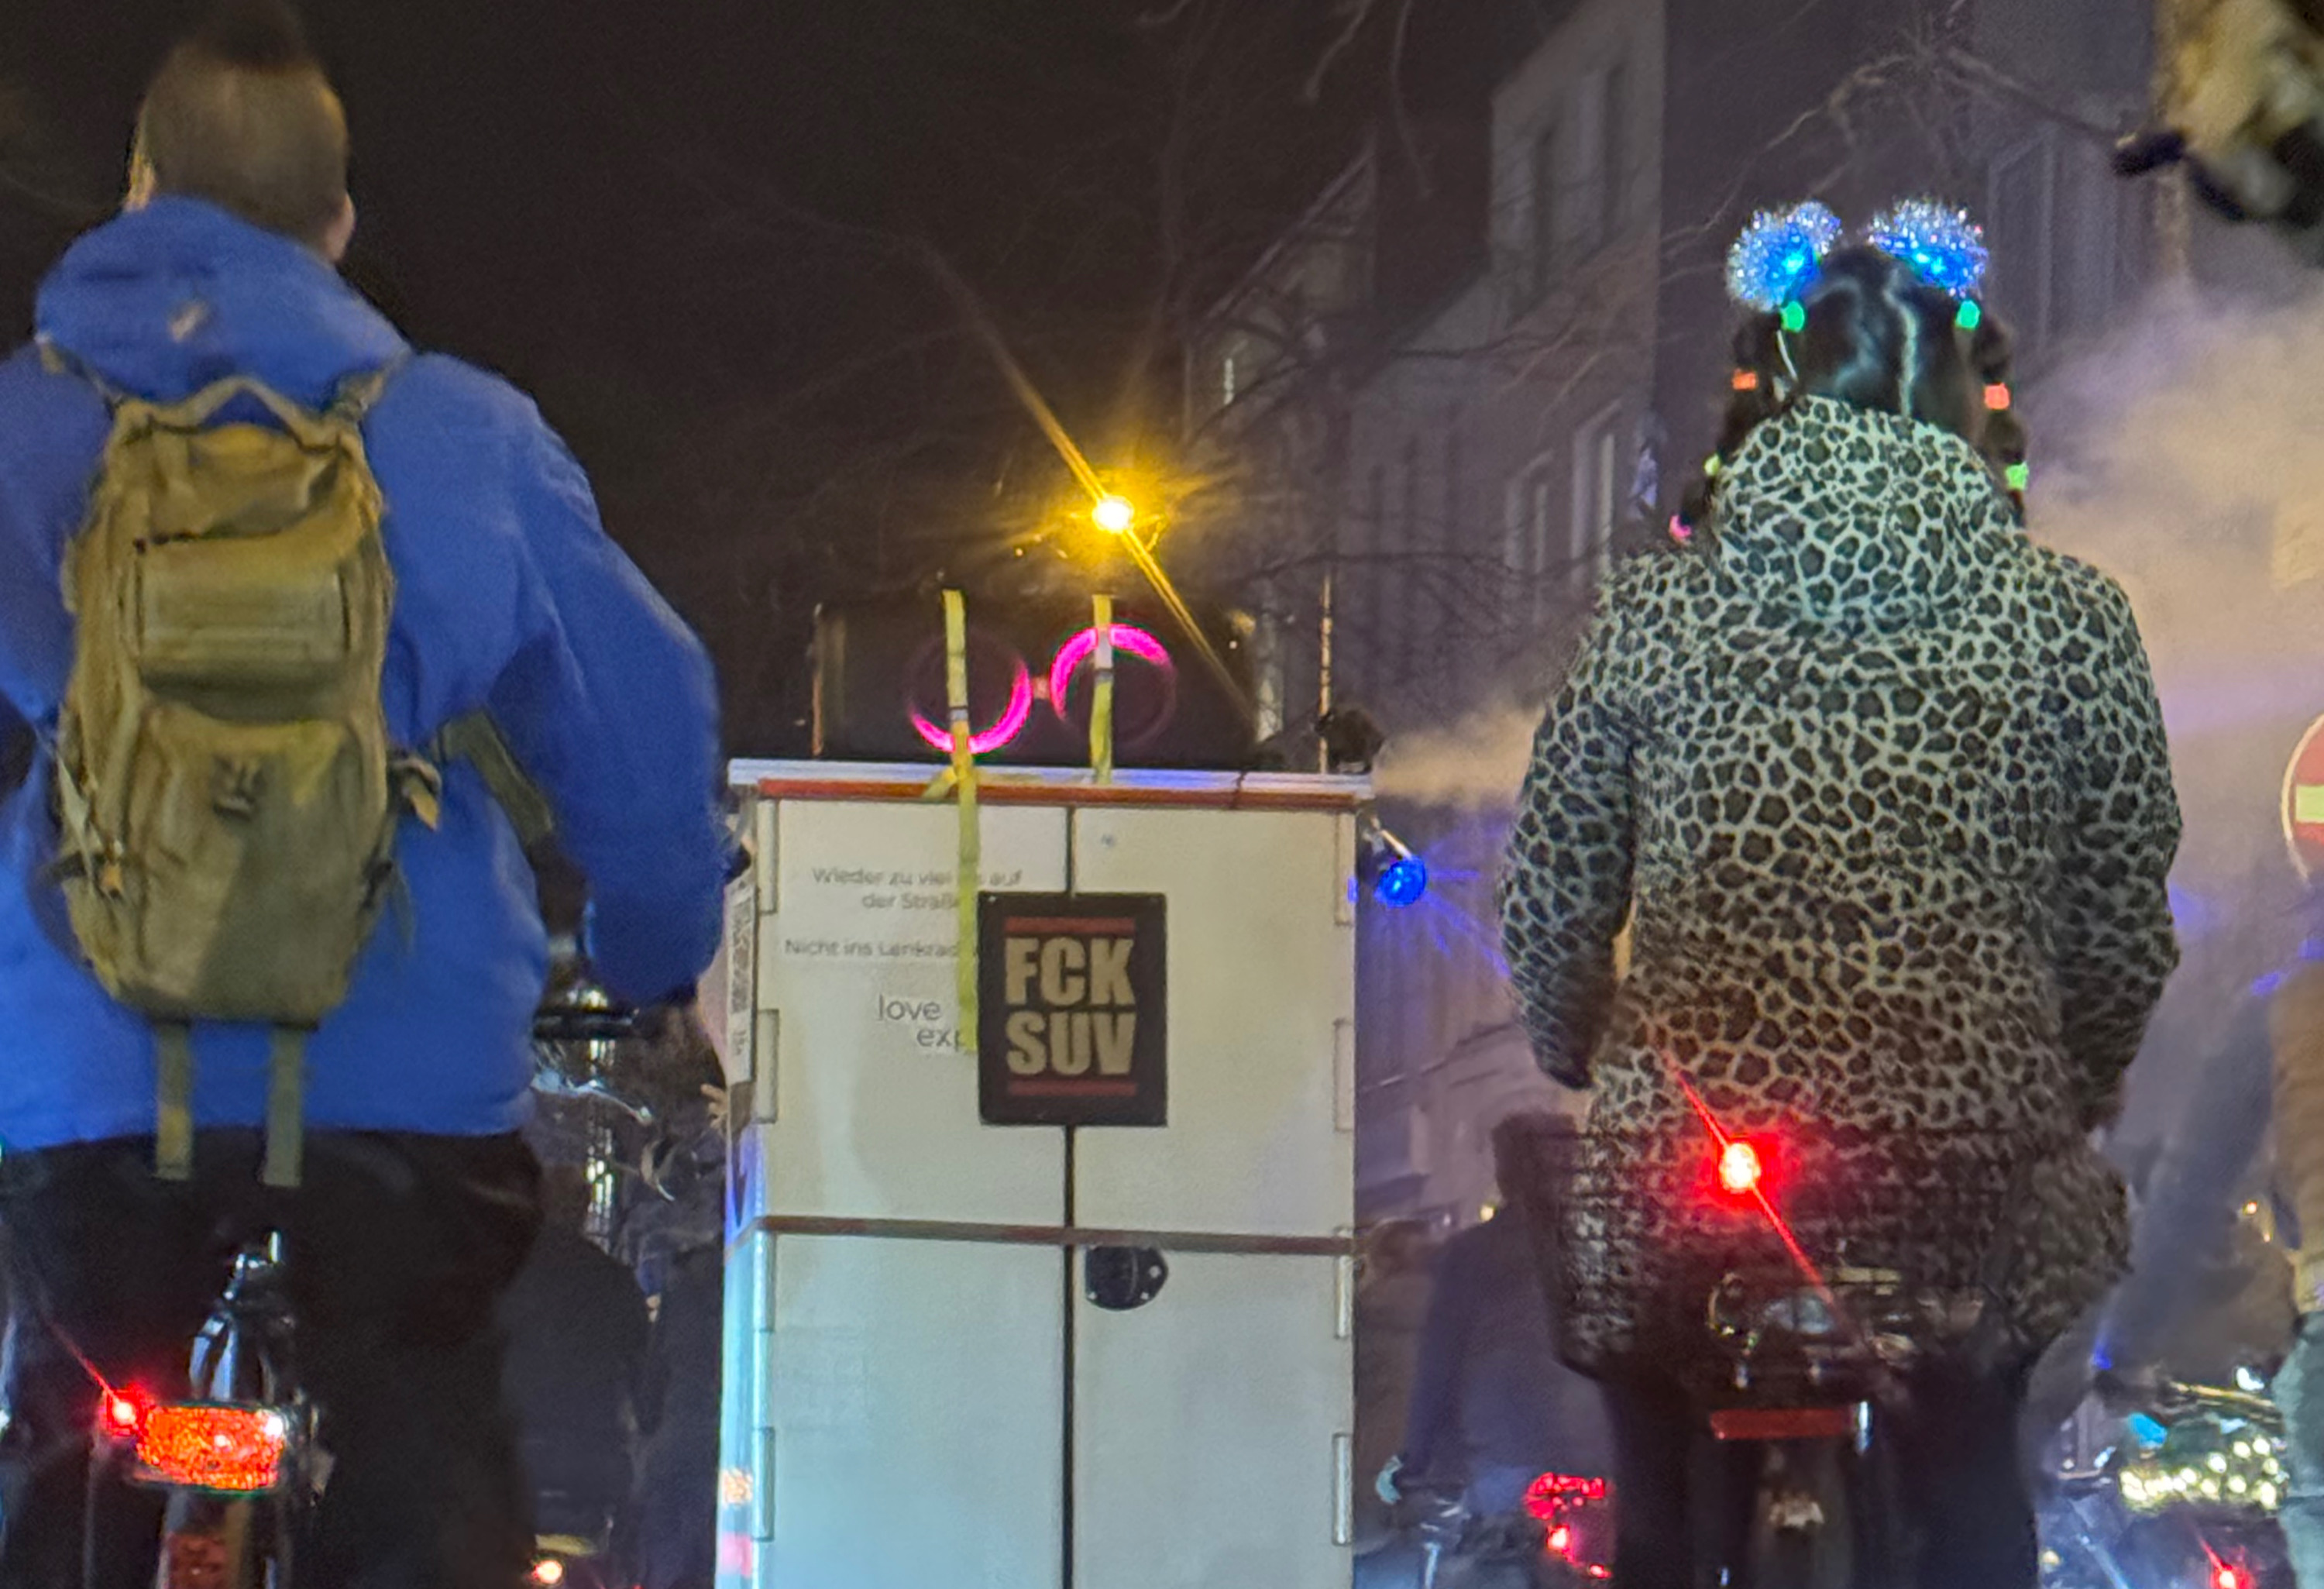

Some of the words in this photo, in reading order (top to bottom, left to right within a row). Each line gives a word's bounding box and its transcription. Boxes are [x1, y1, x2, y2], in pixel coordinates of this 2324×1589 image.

[812, 867, 884, 886] Wieder
[862, 893, 896, 909] der
[785, 938, 839, 957] Nicht
[1005, 936, 1136, 1006] FCK
[878, 993, 942, 1021] love
[1005, 1010, 1137, 1075] SUV
